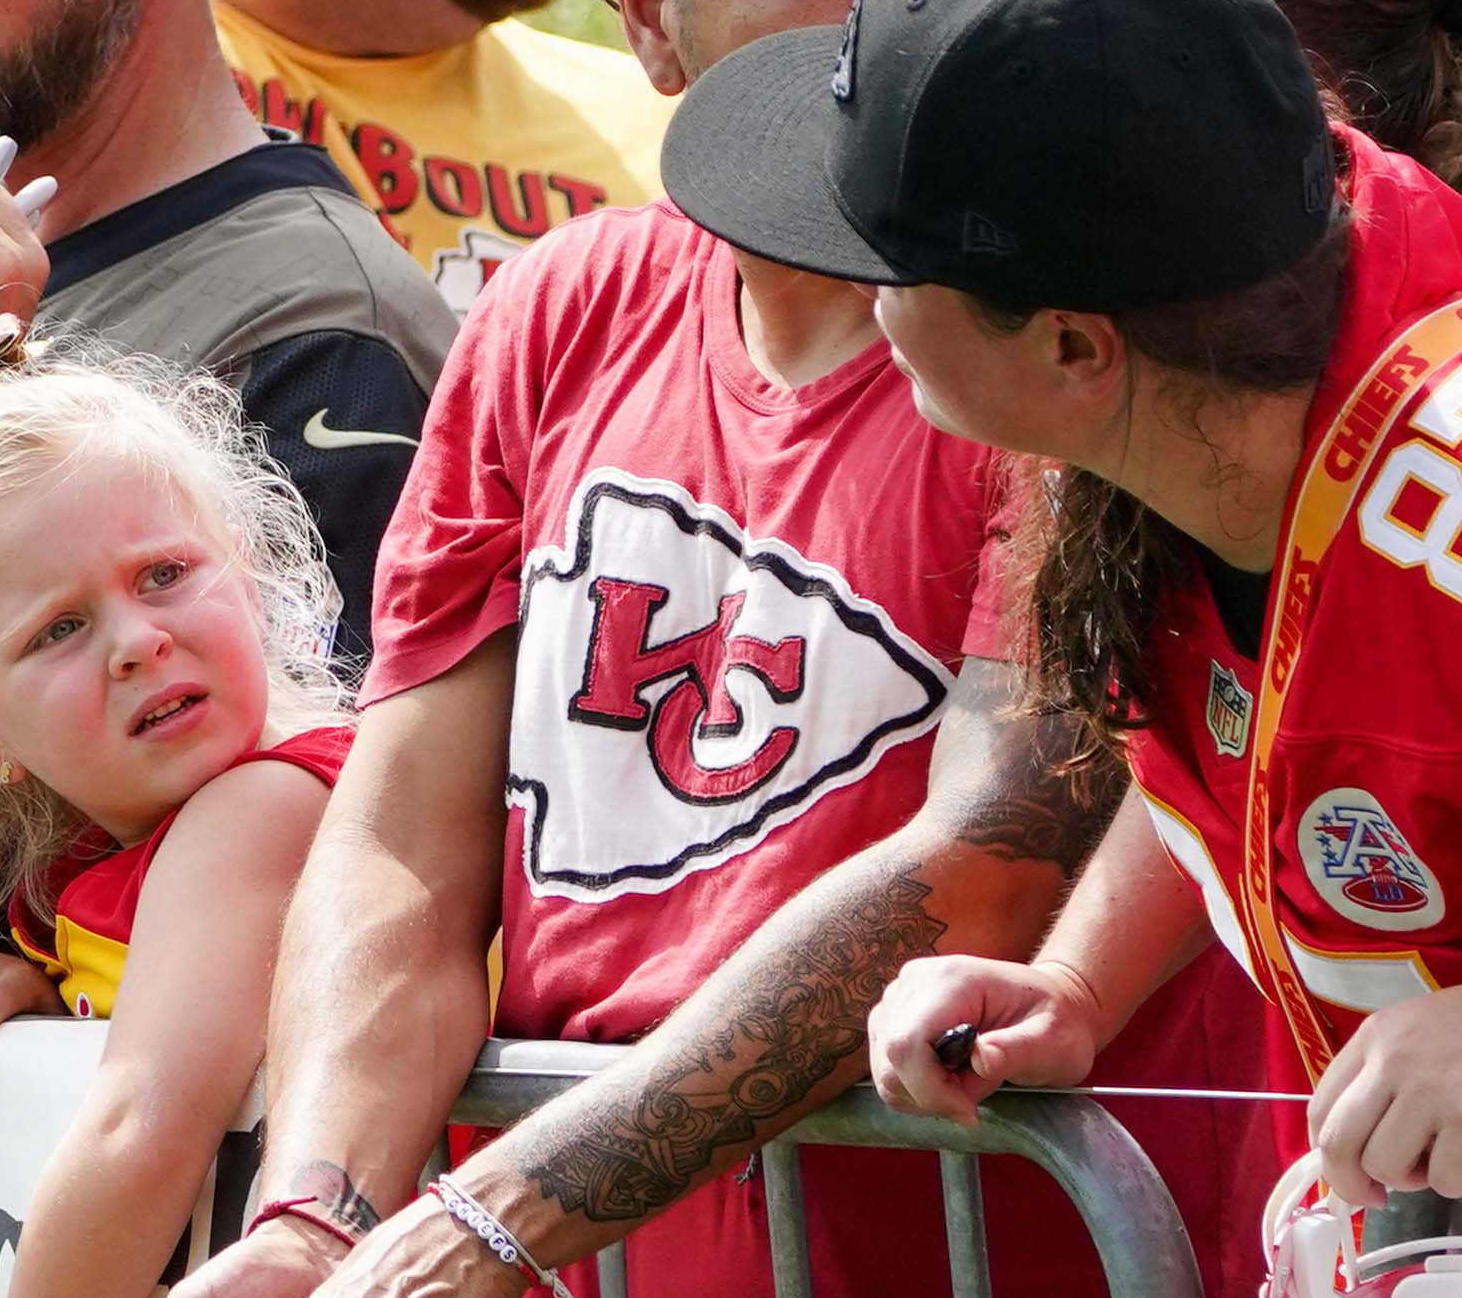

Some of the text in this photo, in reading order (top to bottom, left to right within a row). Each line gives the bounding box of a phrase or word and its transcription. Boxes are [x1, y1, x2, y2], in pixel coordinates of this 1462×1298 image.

[1324, 343, 1430, 483] CHIEFS
[567, 576, 806, 807] KC
[1212, 691, 1239, 743] NFL
[448, 1200, 516, 1261] CHIEFS
